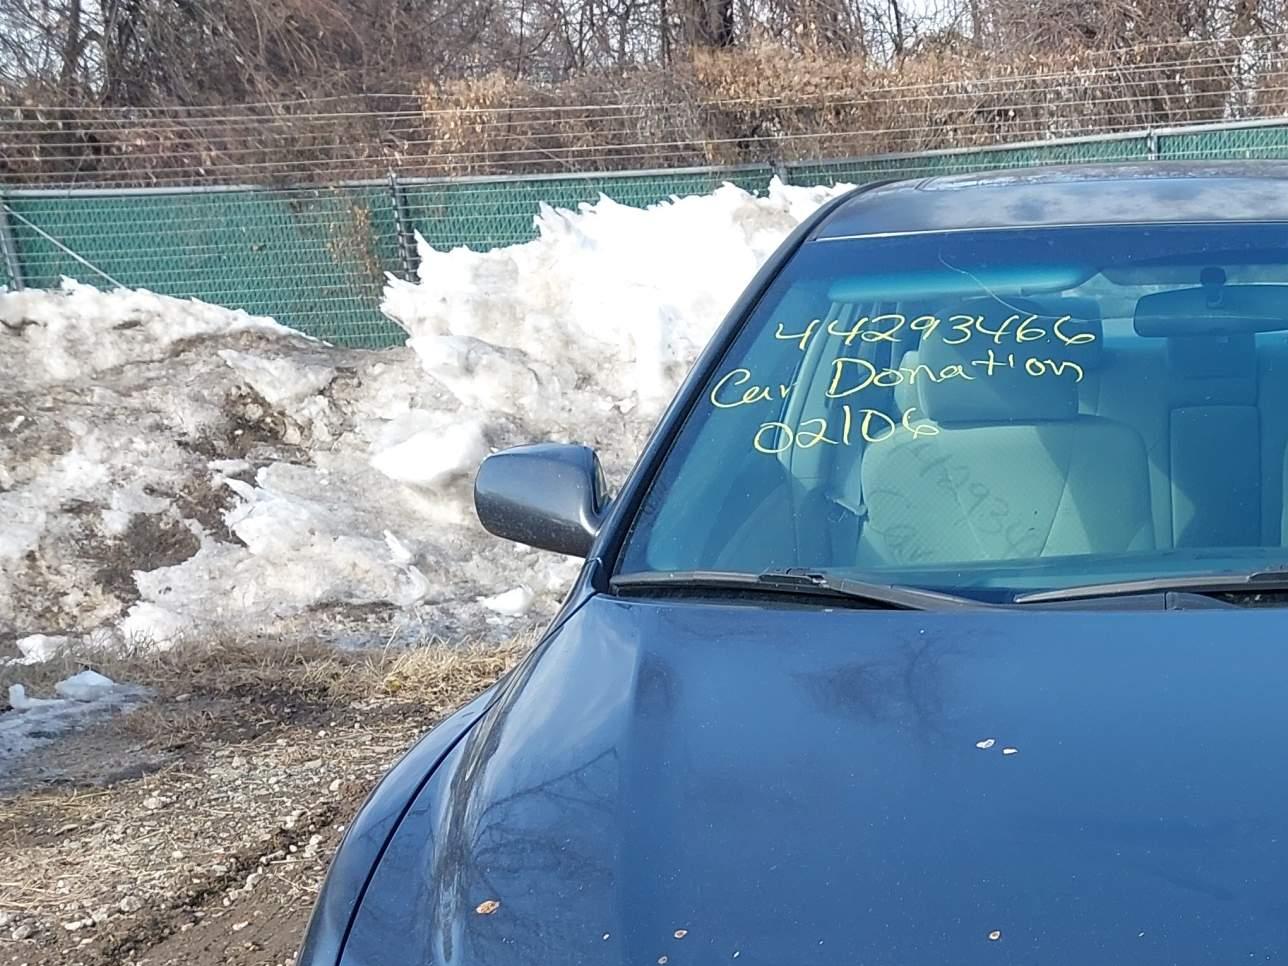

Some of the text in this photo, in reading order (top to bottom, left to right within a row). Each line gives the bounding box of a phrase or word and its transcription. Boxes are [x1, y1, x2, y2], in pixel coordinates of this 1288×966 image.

[775, 315, 1096, 349] 44293466
[710, 349, 1083, 409] Car Donation
